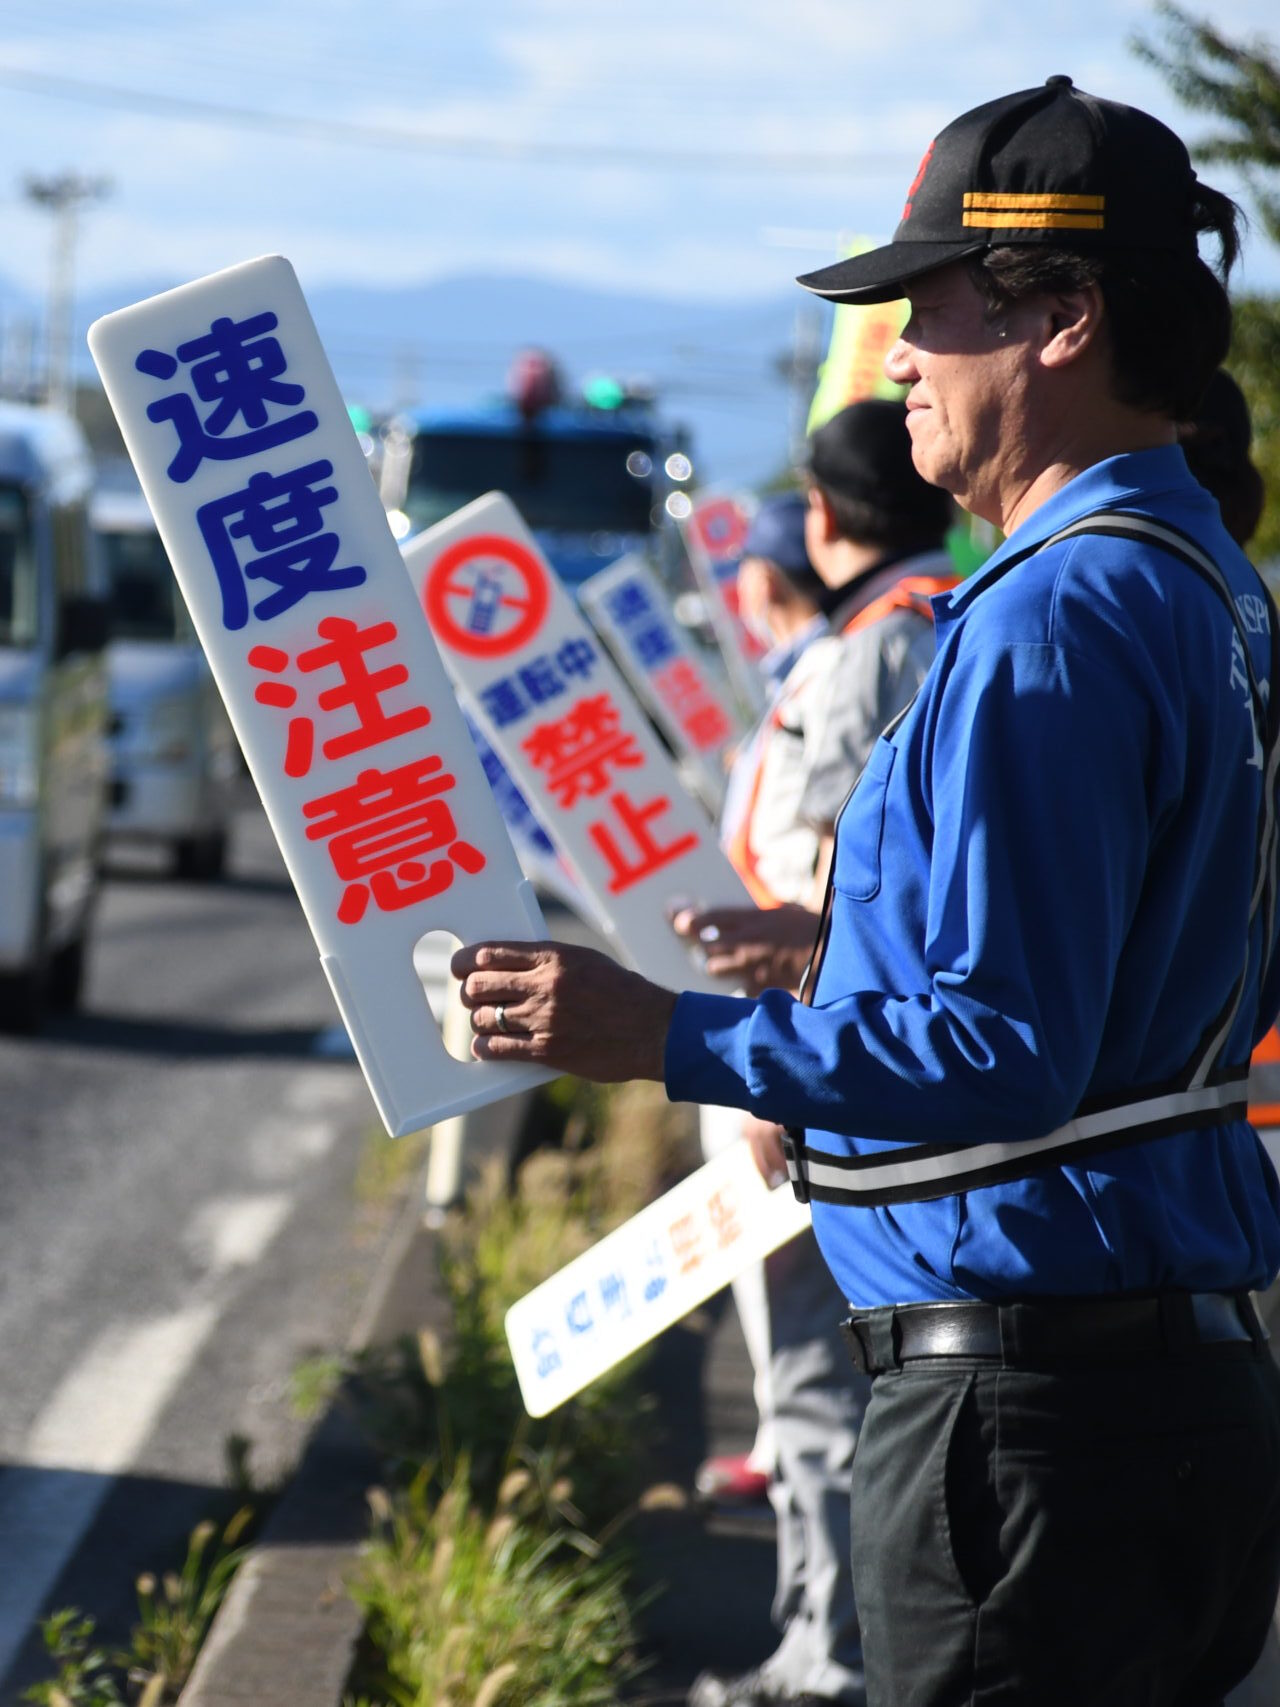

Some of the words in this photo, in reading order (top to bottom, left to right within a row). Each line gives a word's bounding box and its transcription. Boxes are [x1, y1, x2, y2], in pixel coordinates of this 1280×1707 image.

[135, 311, 486, 925] 速度注意
[480, 636, 596, 729] 運転中
[521, 690, 701, 895] 禁止
